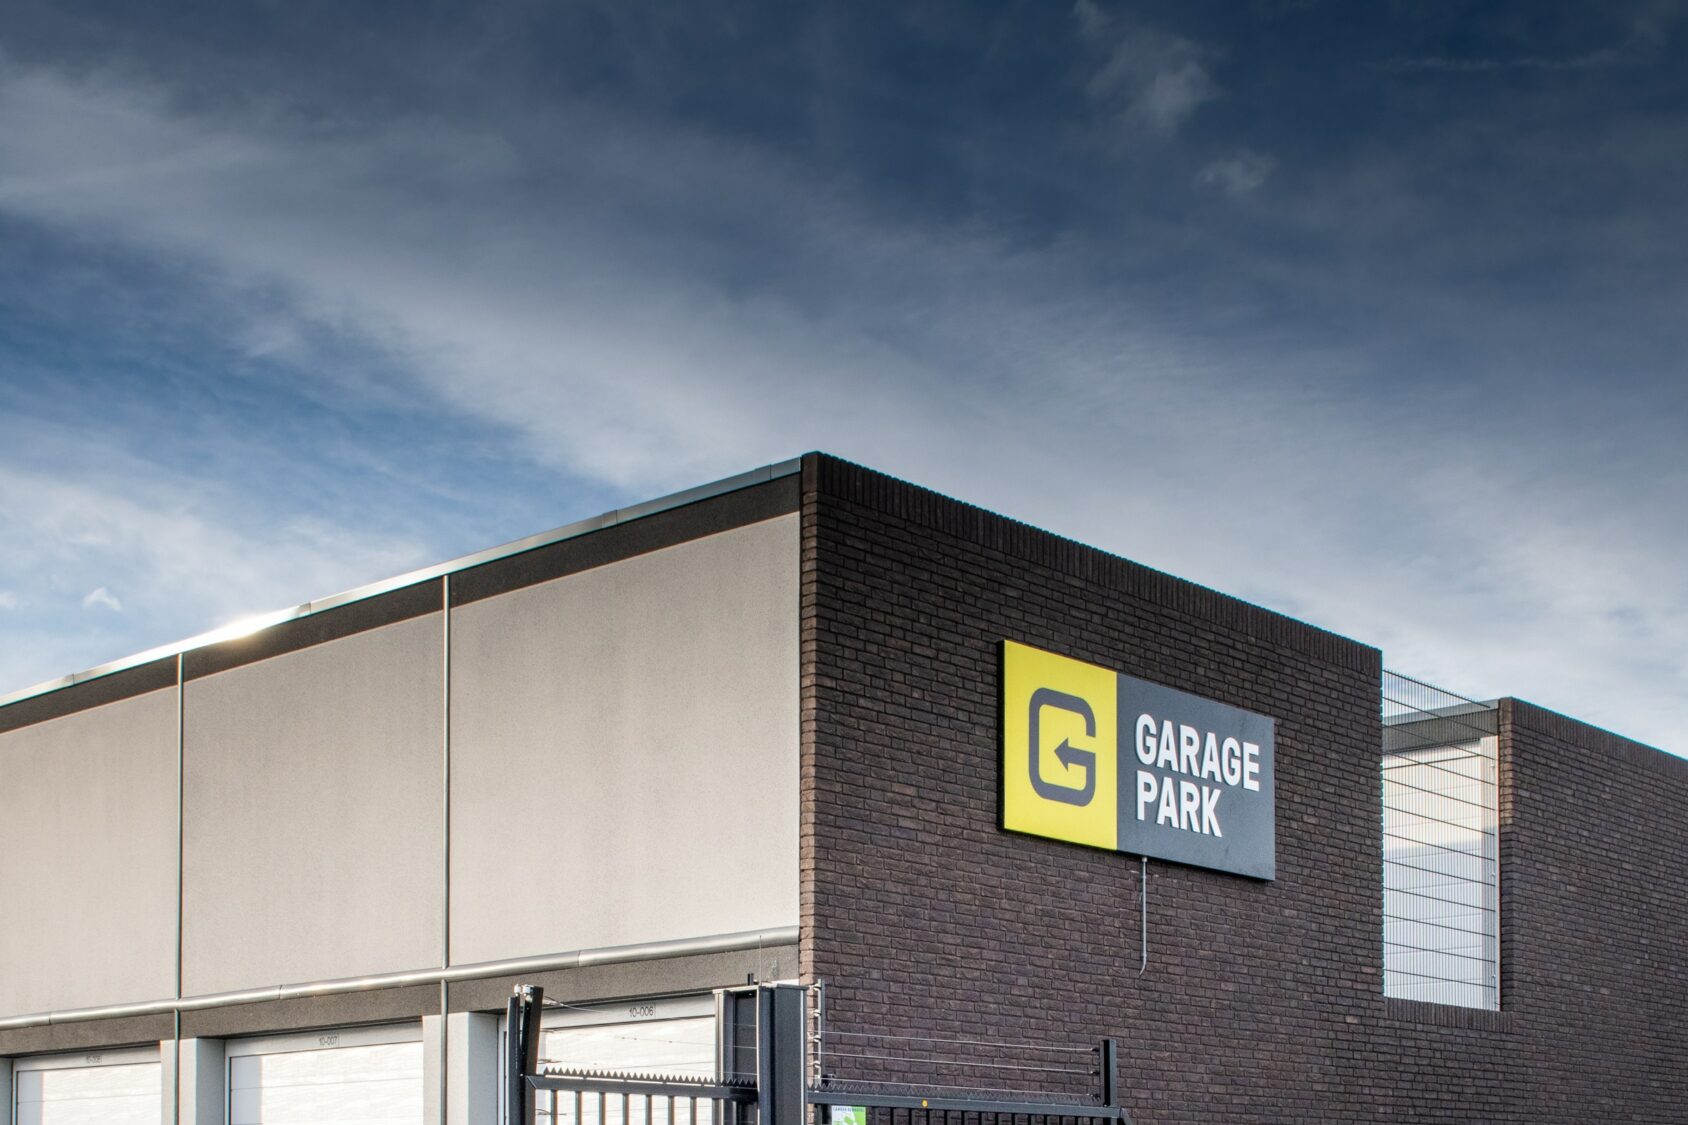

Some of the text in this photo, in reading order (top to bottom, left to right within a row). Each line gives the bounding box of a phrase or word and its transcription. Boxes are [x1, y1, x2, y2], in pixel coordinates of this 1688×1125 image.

[1135, 713, 1260, 792] GARAGE
[1136, 770, 1223, 838] PARK
[629, 1006, 654, 1018] 10-006
